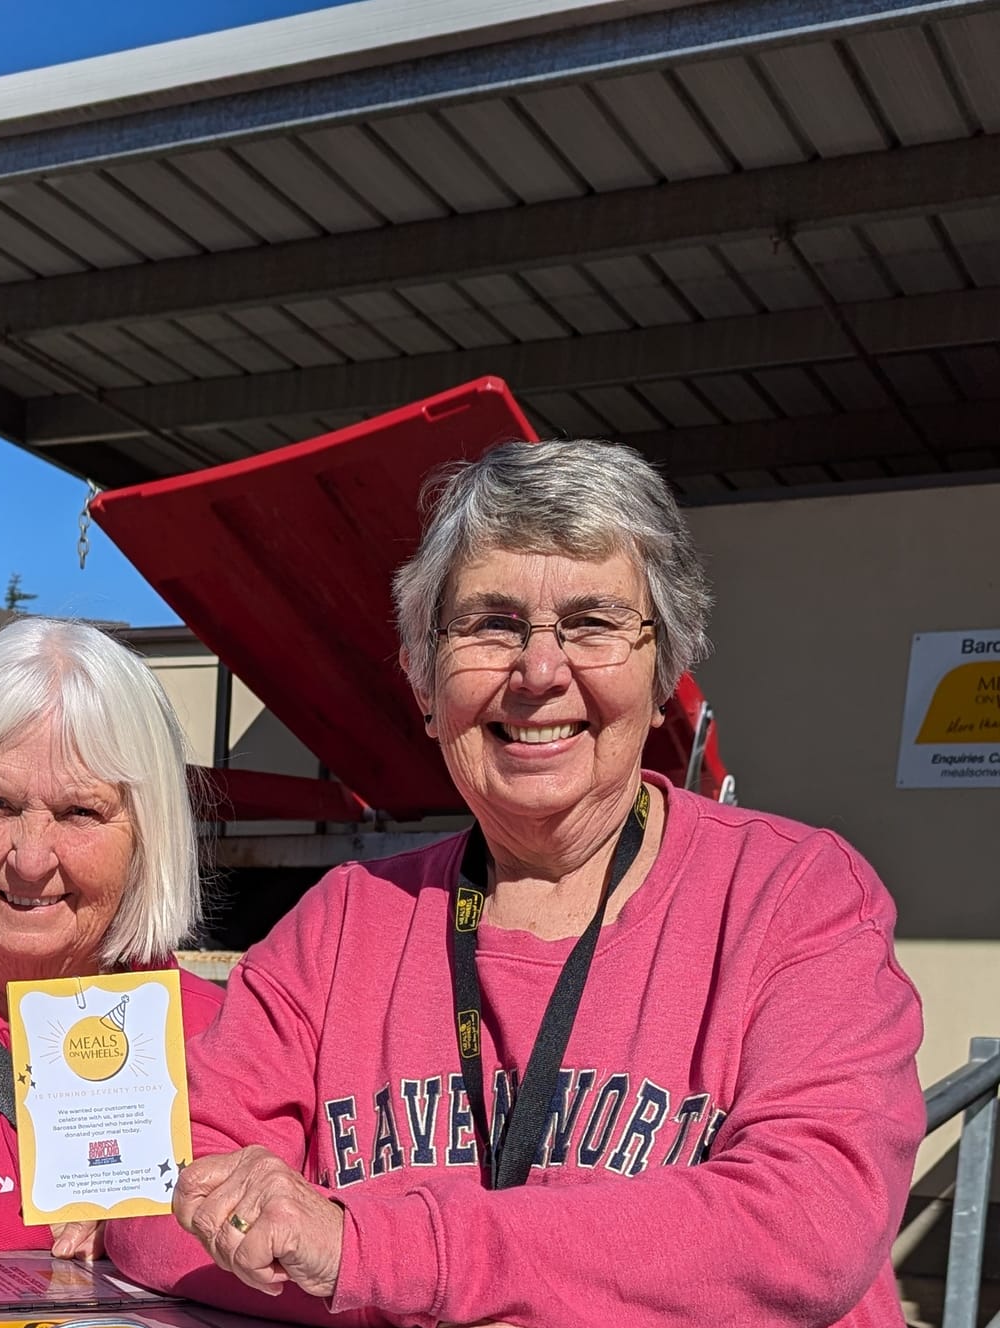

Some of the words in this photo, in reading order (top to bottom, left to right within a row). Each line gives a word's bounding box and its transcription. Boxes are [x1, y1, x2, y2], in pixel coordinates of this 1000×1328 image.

[931, 752, 985, 766] Enquiries
[69, 1035, 118, 1050] MEALS
[80, 1047, 120, 1060] WHEELS
[48, 1090, 87, 1099] TURNING
[91, 1086, 130, 1096] SEVENTY
[134, 1084, 164, 1093] TODAY
[104, 1104, 137, 1112] customers
[52, 1124, 77, 1132] Barossa
[77, 1122, 104, 1130] Bowland
[134, 1117, 153, 1126] kindly
[58, 1115, 88, 1124] celebrate
[64, 1130, 91, 1138] donated
[91, 1130, 105, 1138] your
[90, 1171, 102, 1179] you
[112, 1169, 130, 1178] being
[130, 1168, 143, 1176] part
[76, 1180, 90, 1188] year
[90, 1178, 113, 1187] journey
[82, 1187, 99, 1196] plans
[107, 1185, 121, 1193] slow
